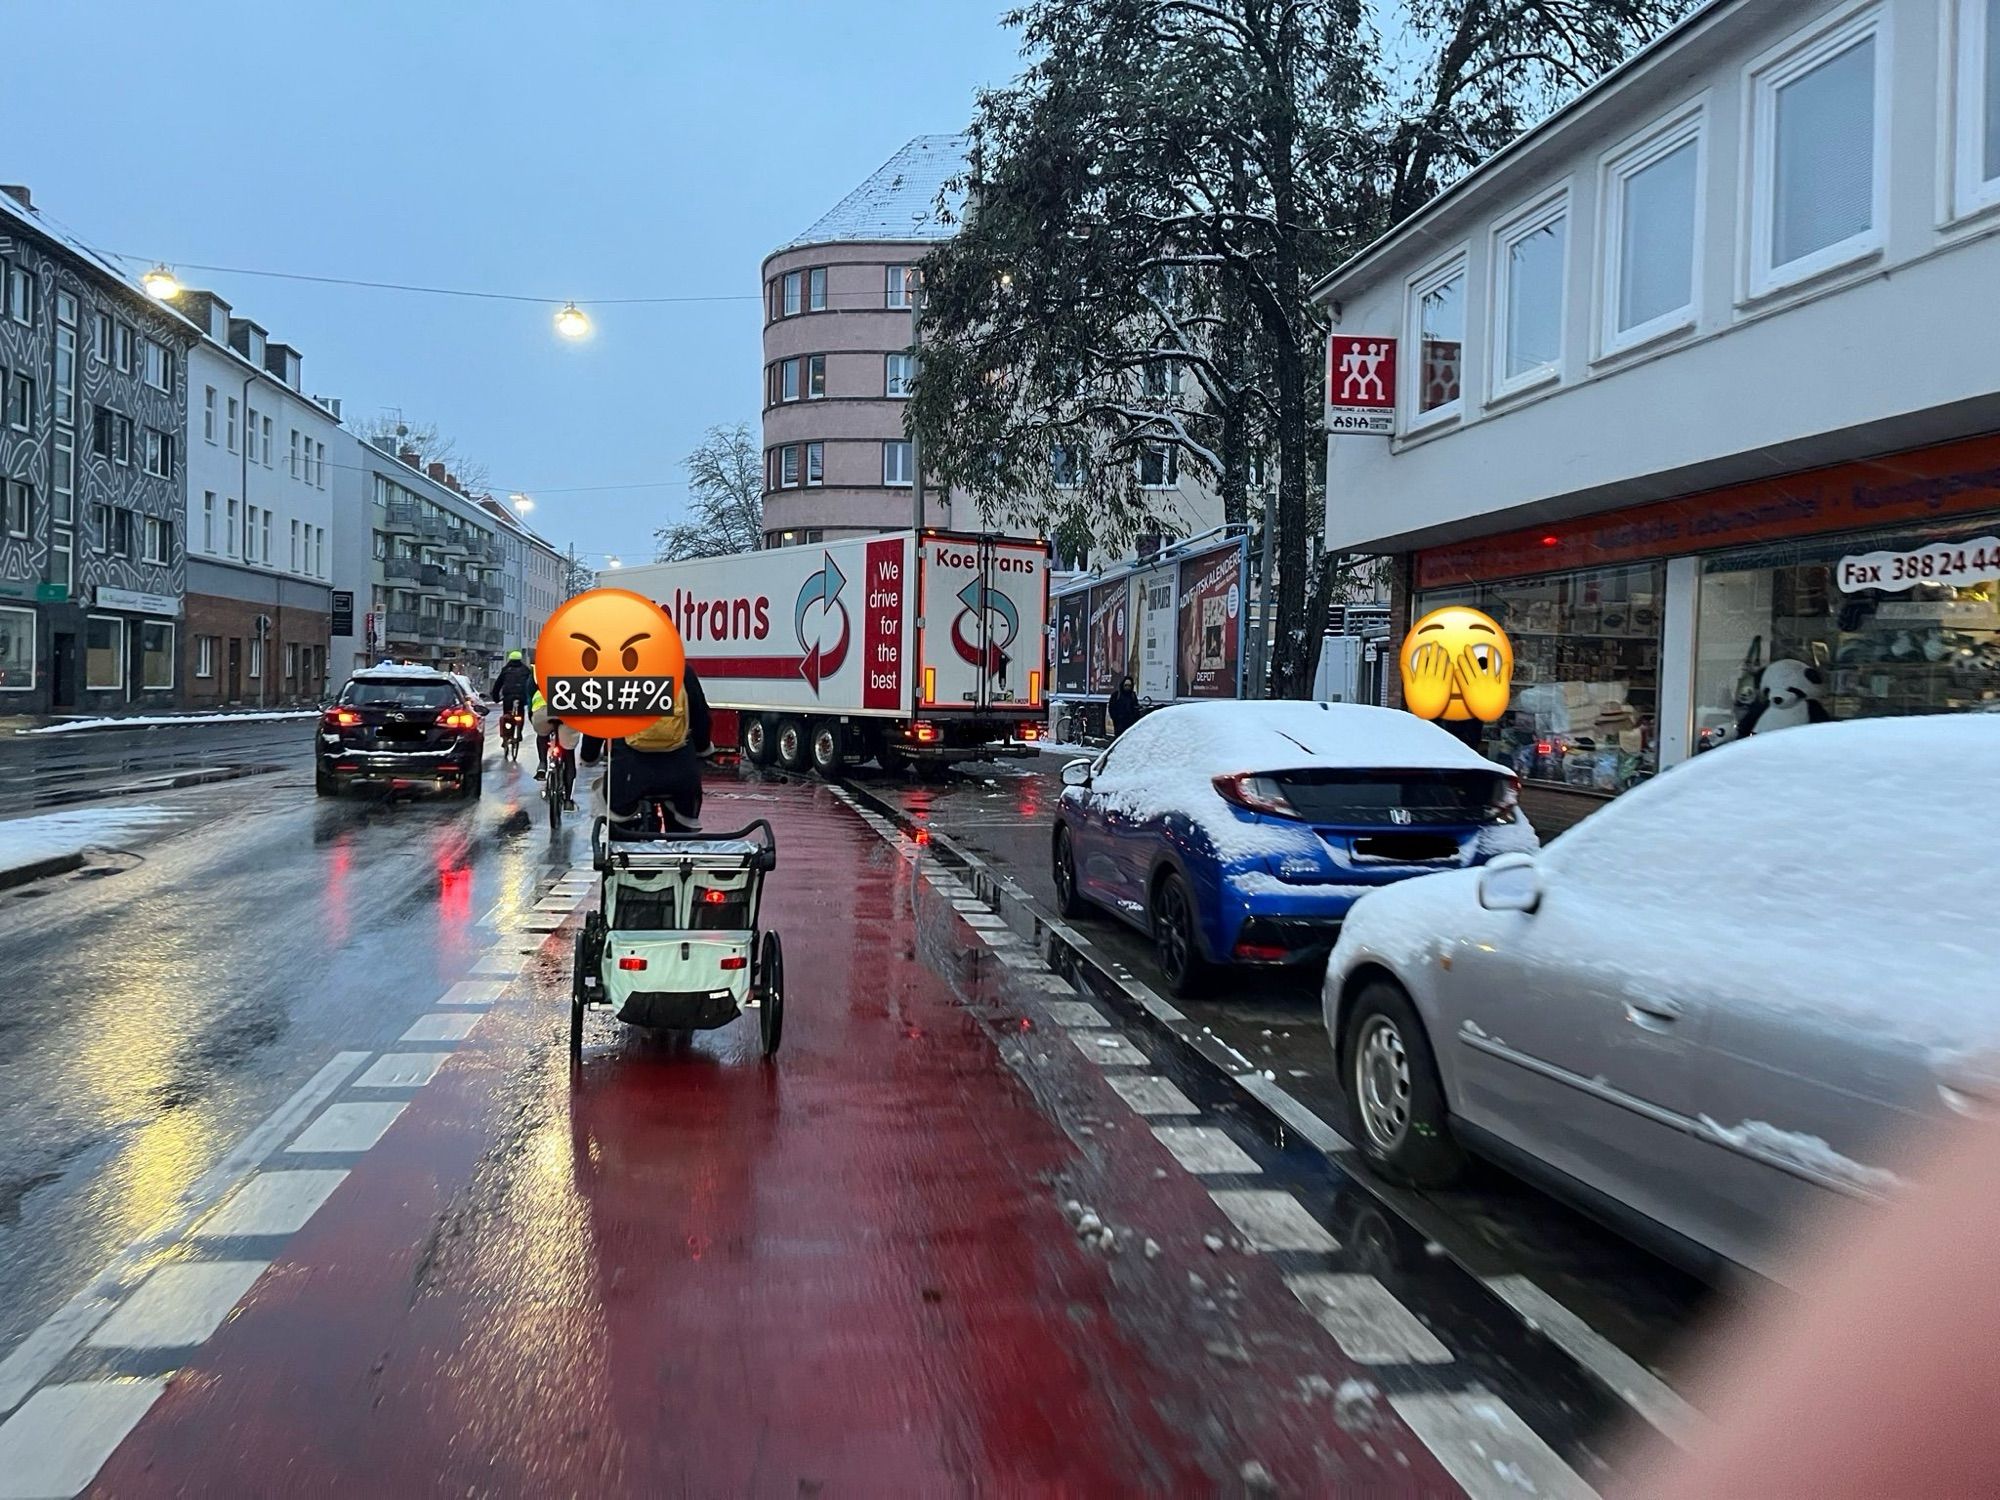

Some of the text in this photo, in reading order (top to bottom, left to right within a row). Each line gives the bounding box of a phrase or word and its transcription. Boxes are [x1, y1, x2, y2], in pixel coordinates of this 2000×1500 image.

[1333, 416, 1369, 428] ASIA
[878, 561, 899, 580] We
[1845, 563, 1881, 584] Fax
[1892, 554, 1934, 580] 388
[1938, 550, 1967, 575] 24
[869, 589, 898, 608] drive
[651, 588, 770, 641] ltrans
[880, 616, 898, 635] for
[877, 643, 897, 662] the
[871, 670, 897, 689] best
[1196, 671, 1216, 682] DEPOT
